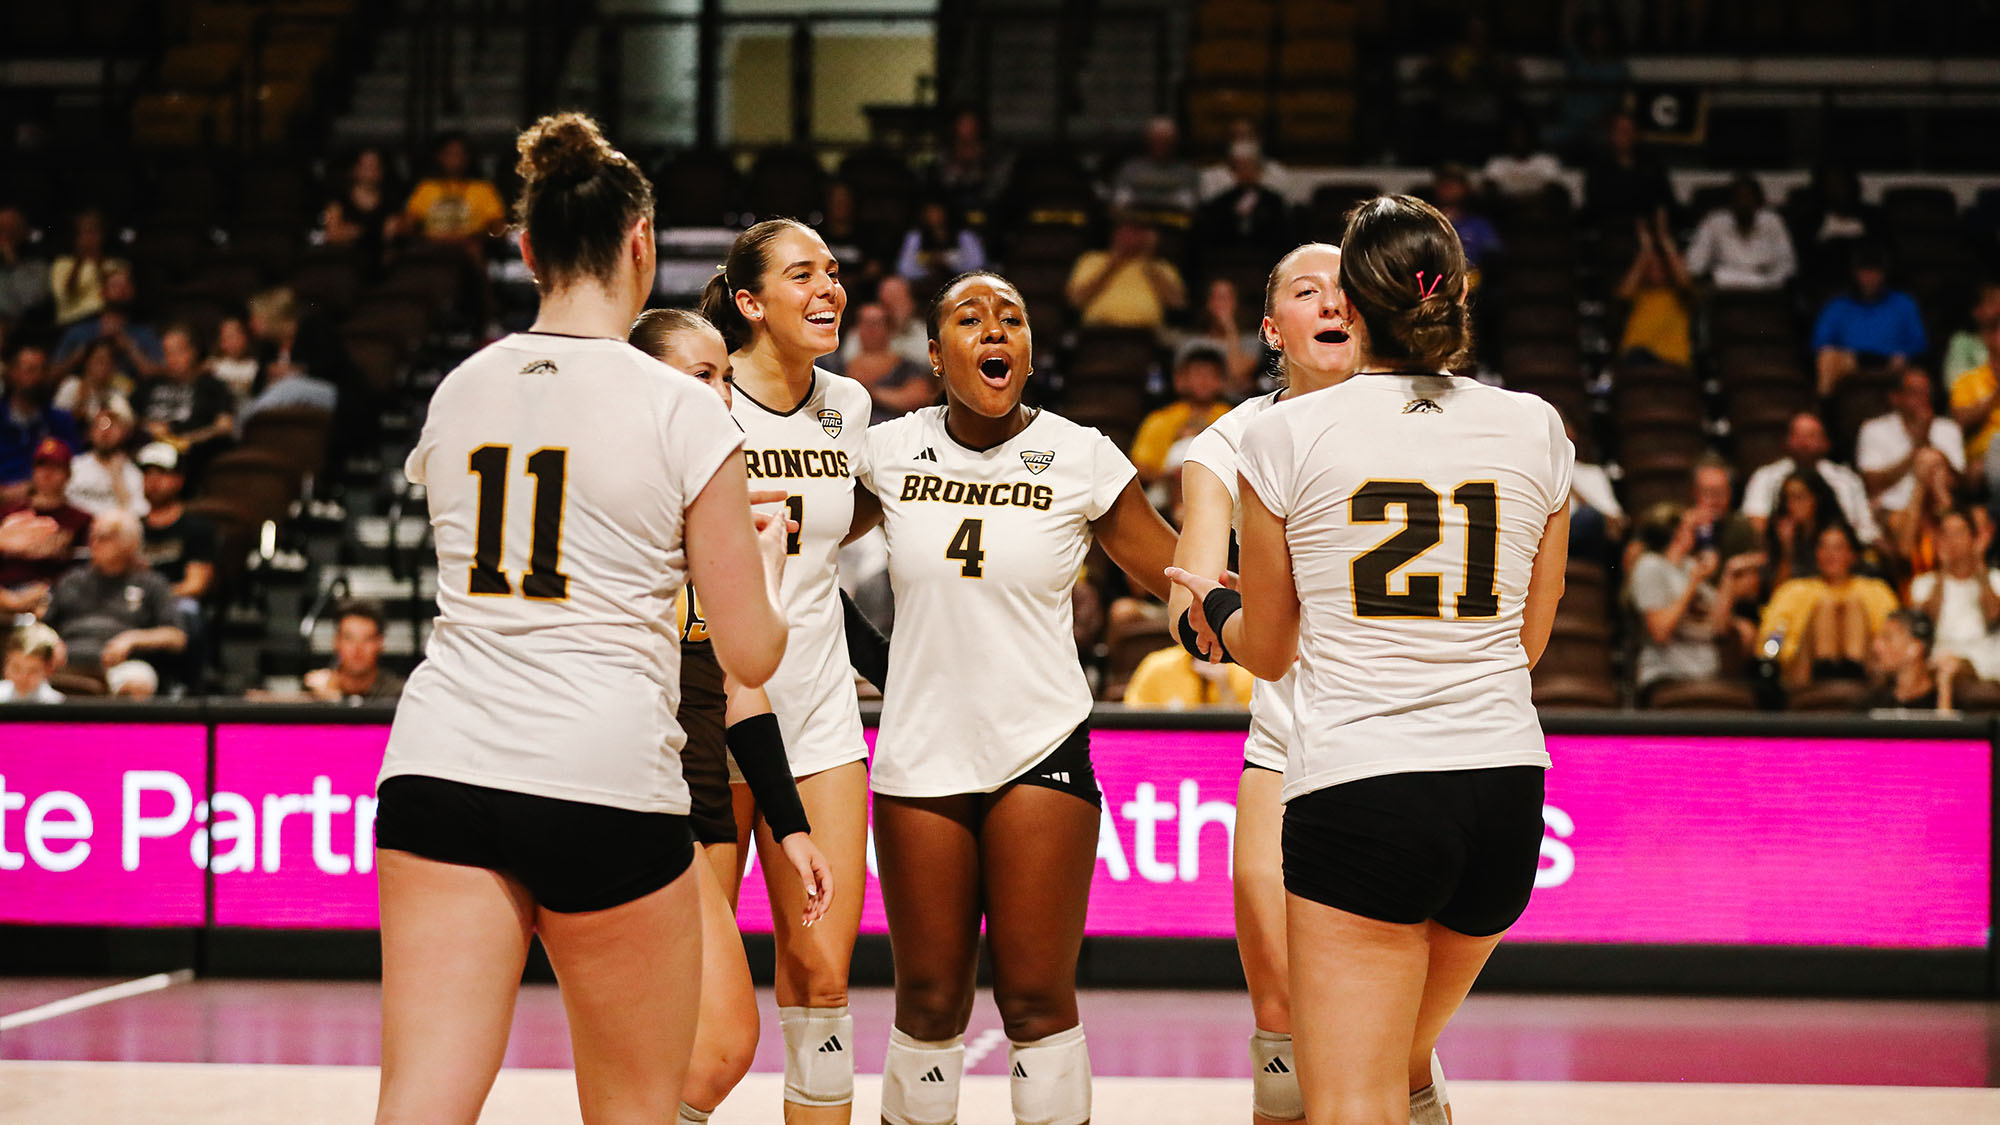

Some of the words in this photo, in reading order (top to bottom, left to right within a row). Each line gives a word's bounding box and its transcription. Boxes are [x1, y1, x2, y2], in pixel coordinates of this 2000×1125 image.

[821, 418, 842, 427] MAC
[744, 449, 850, 479] RONCOS
[1022, 455, 1053, 464] MAC
[899, 474, 1054, 512] BRONCOS
[468, 442, 570, 602] 11
[944, 518, 986, 580] 4
[1347, 477, 1501, 620] 21
[1096, 778, 1238, 883] Ath
